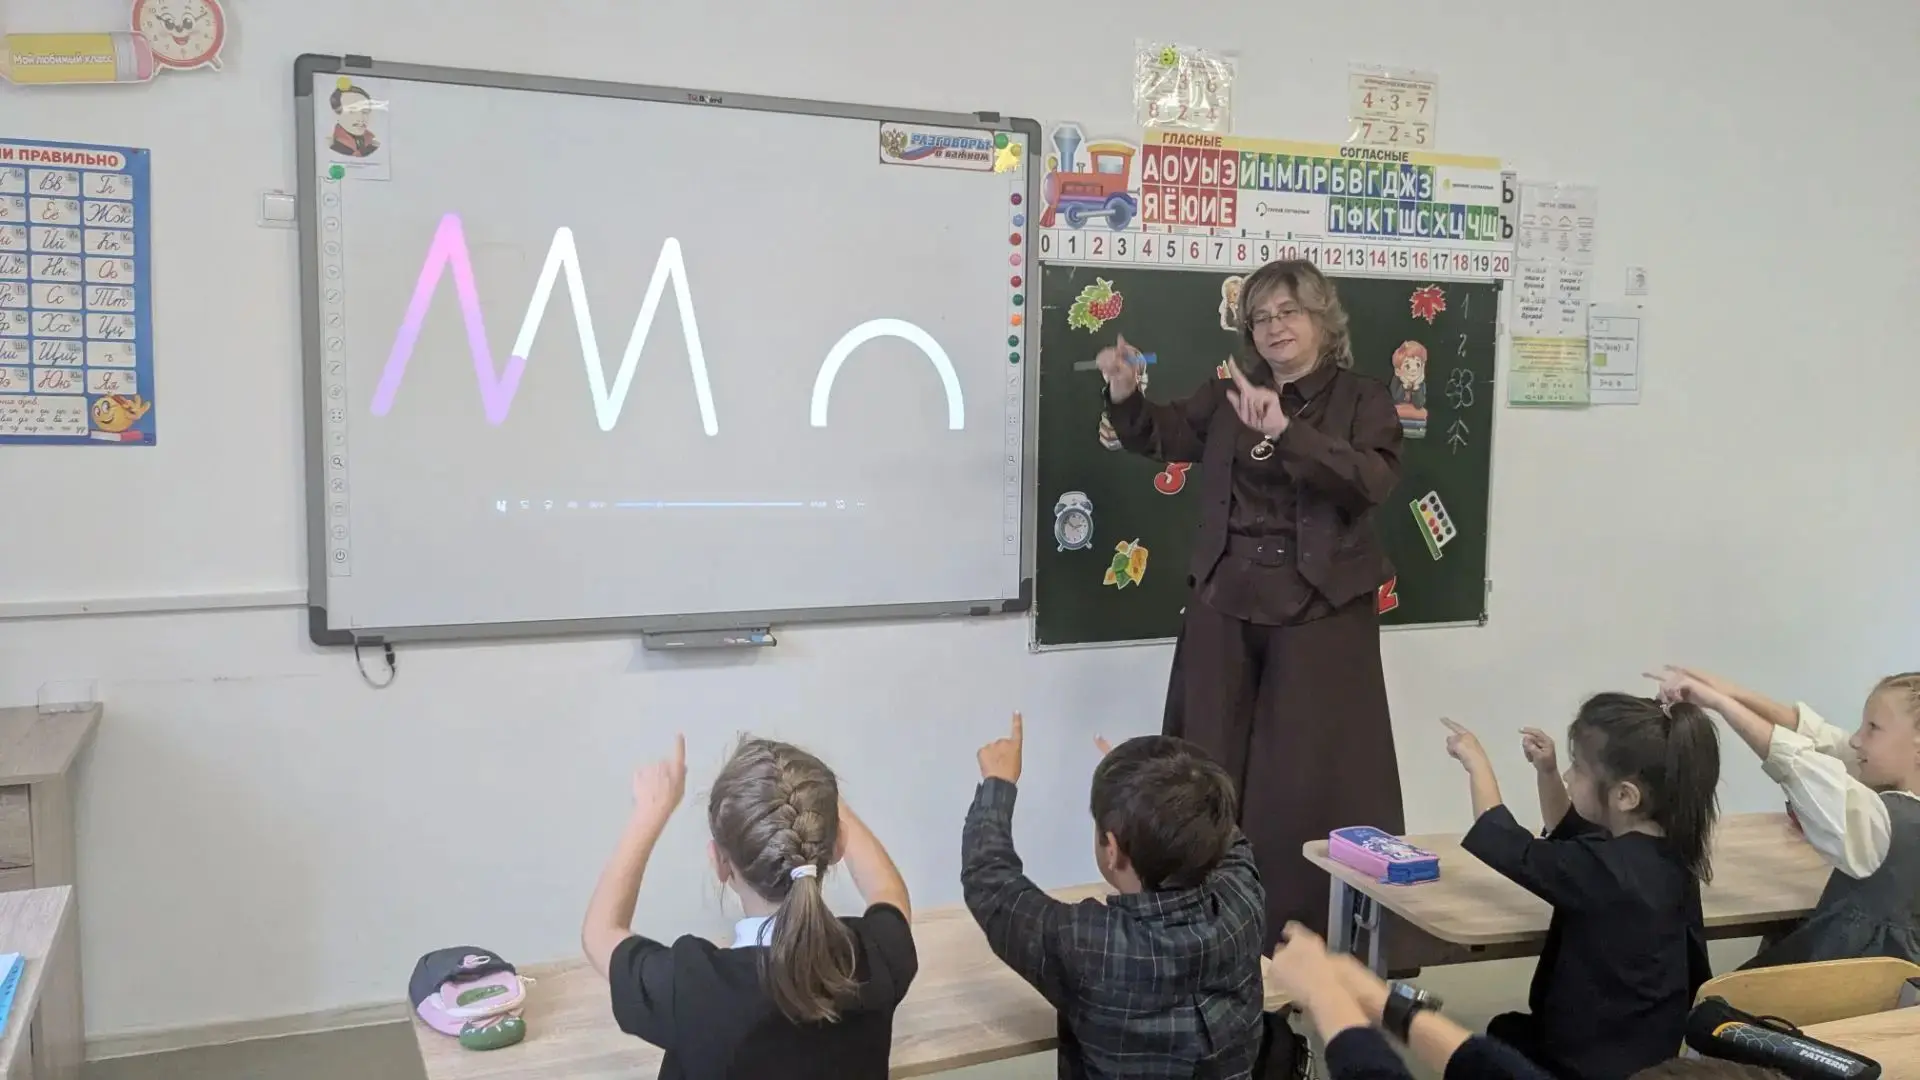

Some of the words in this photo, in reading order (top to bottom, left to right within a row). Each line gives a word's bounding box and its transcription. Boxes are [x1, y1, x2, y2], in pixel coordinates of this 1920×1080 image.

[13, 53, 35, 64] Мой
[36, 52, 83, 65] любимый
[84, 55, 113, 64] класс
[1362, 92, 1374, 108] 4
[1390, 94, 1400, 111] 3
[1417, 97, 1428, 113] 7
[1178, 104, 1188, 121] 2
[911, 132, 993, 151] РАЗГОВОРЫ
[1162, 132, 1223, 147] ГЛАСНЫЕ
[1362, 122, 1372, 139] 7
[1389, 125, 1398, 142] 2
[1416, 128, 1425, 144] 5
[0, 148, 13, 160] И
[19, 149, 119, 167] ПРАВИЛЬНО
[945, 150, 990, 161] важном
[1340, 146, 1410, 162] СОГЛАСНЫЕ
[1041, 235, 1050, 253] 0
[1068, 236, 1076, 254] 1
[1093, 237, 1103, 254] 2
[1117, 238, 1127, 255] 3
[1142, 239, 1152, 256] 4
[1167, 240, 1176, 258] 5
[1190, 241, 1199, 259] 6
[1214, 243, 1223, 260] 7
[1237, 244, 1246, 261] 8
[1260, 245, 1269, 261] 9
[1279, 246, 1297, 261] 10
[1303, 247, 1319, 264] 11
[1325, 247, 1341, 265] 12
[1347, 248, 1364, 266] 13
[1369, 249, 1386, 267] 14
[1391, 250, 1408, 268] 15
[1412, 251, 1428, 269] 16
[1433, 252, 1449, 270] 17
[1453, 253, 1469, 271] 18
[1473, 254, 1489, 271] 19
[1494, 256, 1509, 273] 20
[1799, 1049, 1850, 1072] PATTERN
